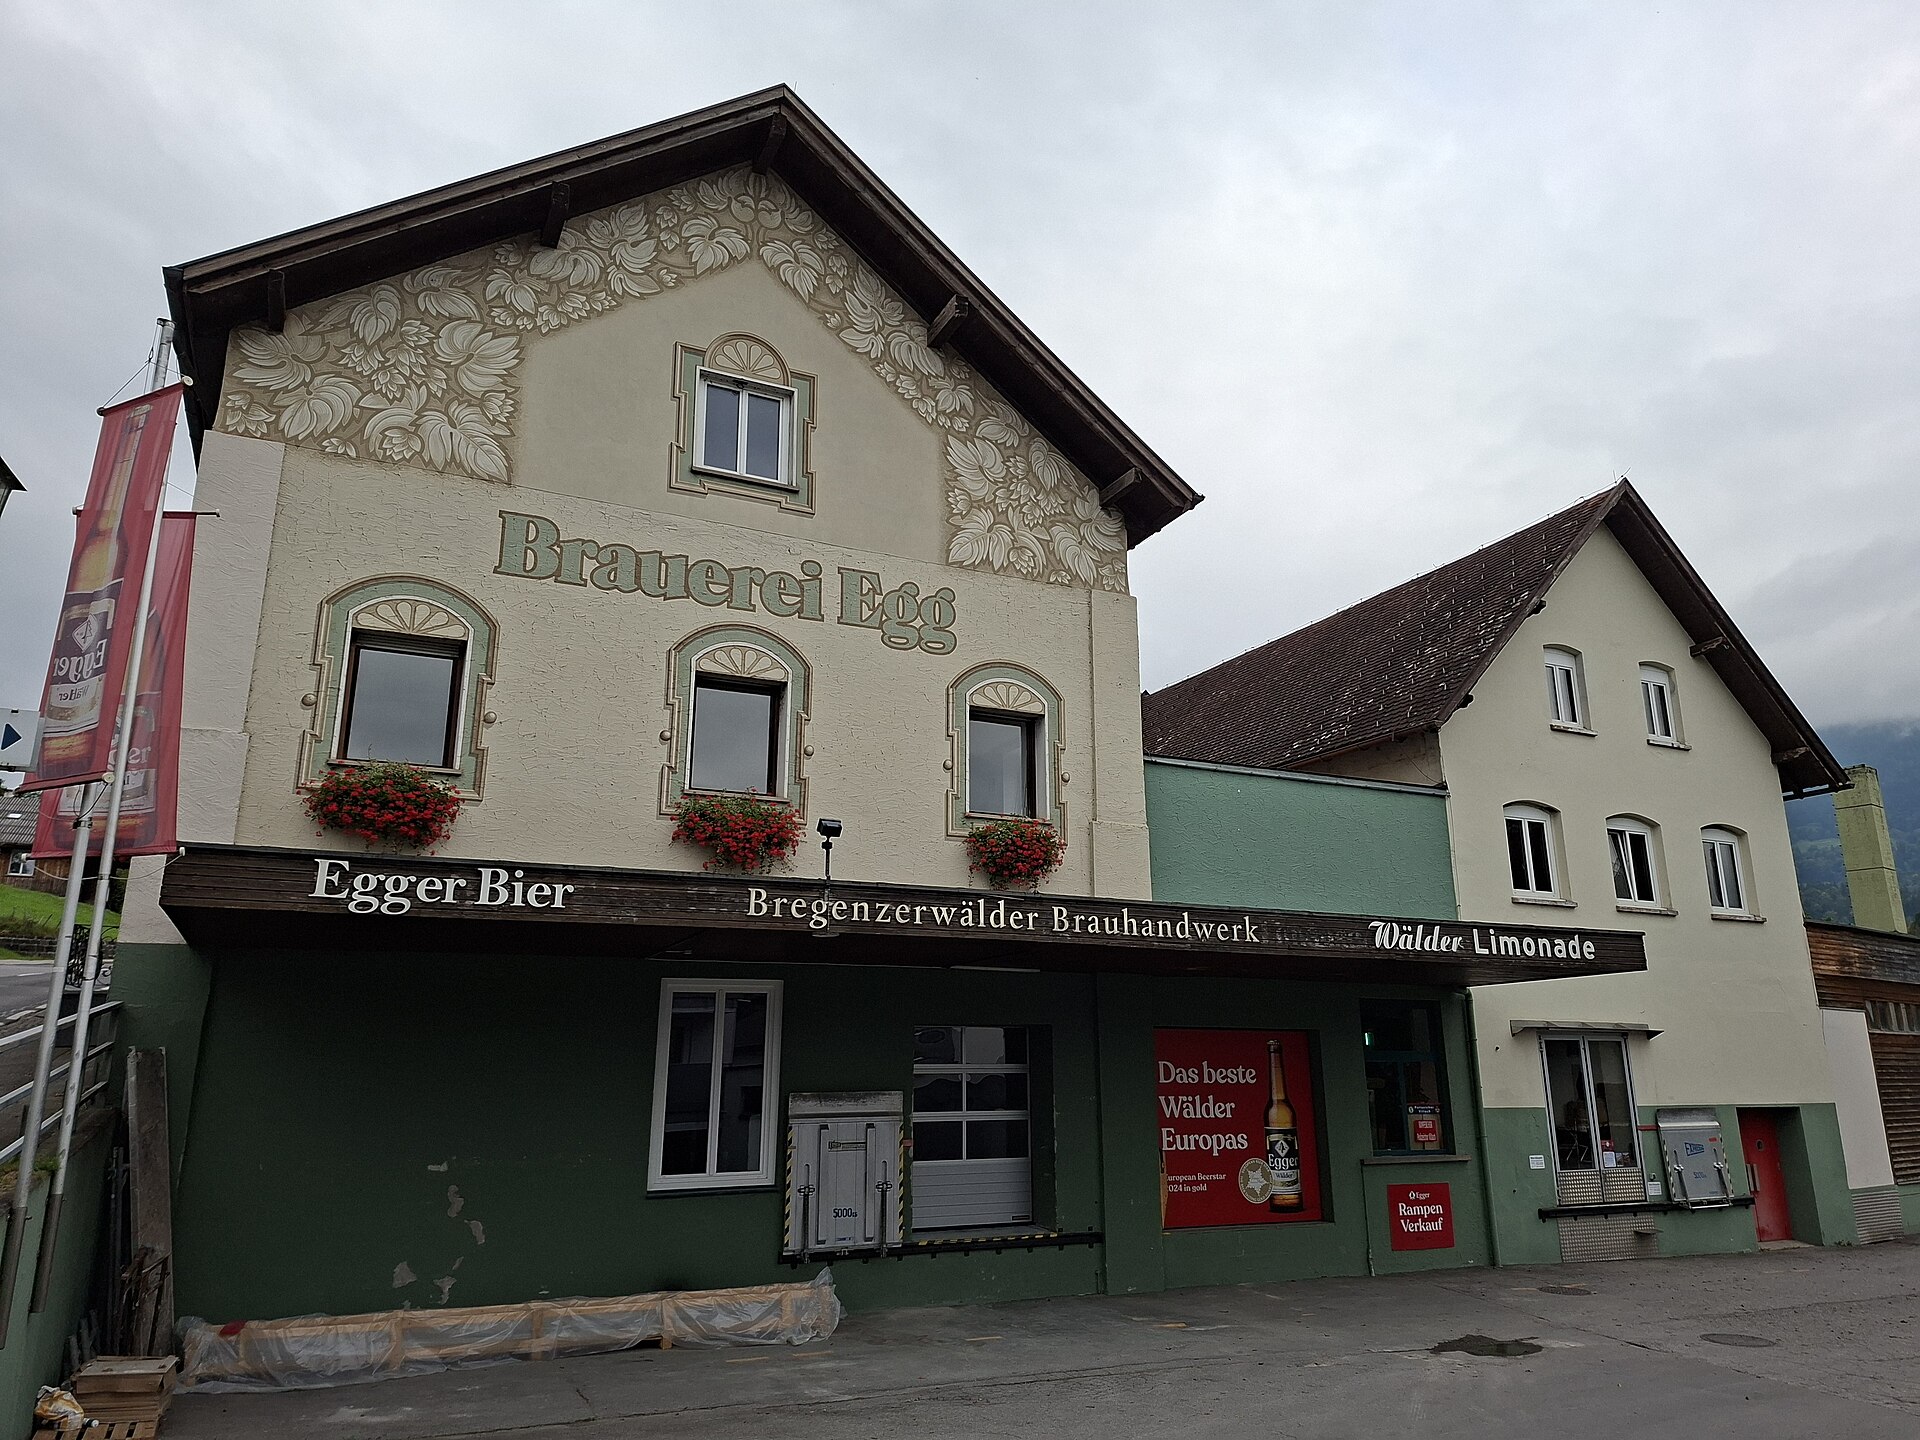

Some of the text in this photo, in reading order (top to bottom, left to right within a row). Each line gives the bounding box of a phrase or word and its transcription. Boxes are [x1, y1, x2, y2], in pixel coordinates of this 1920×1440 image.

[494, 510, 957, 655] Brauerei Egg
[308, 858, 574, 915] Egger Bier
[746, 887, 1260, 943] Bregenzerwälder Brauhandwerk
[1368, 921, 1595, 960] Wälder Limonade
[1158, 1060, 1257, 1084] Das beste
[1158, 1094, 1236, 1119] Wälder
[1161, 1127, 1249, 1157] Europas
[1268, 1153, 1299, 1170] Egger
[1167, 1172, 1227, 1183] uropean Beerstar
[1168, 1183, 1207, 1192] 024 in gold
[1398, 1202, 1443, 1218] Rampen
[1400, 1217, 1444, 1233] Verkauf
